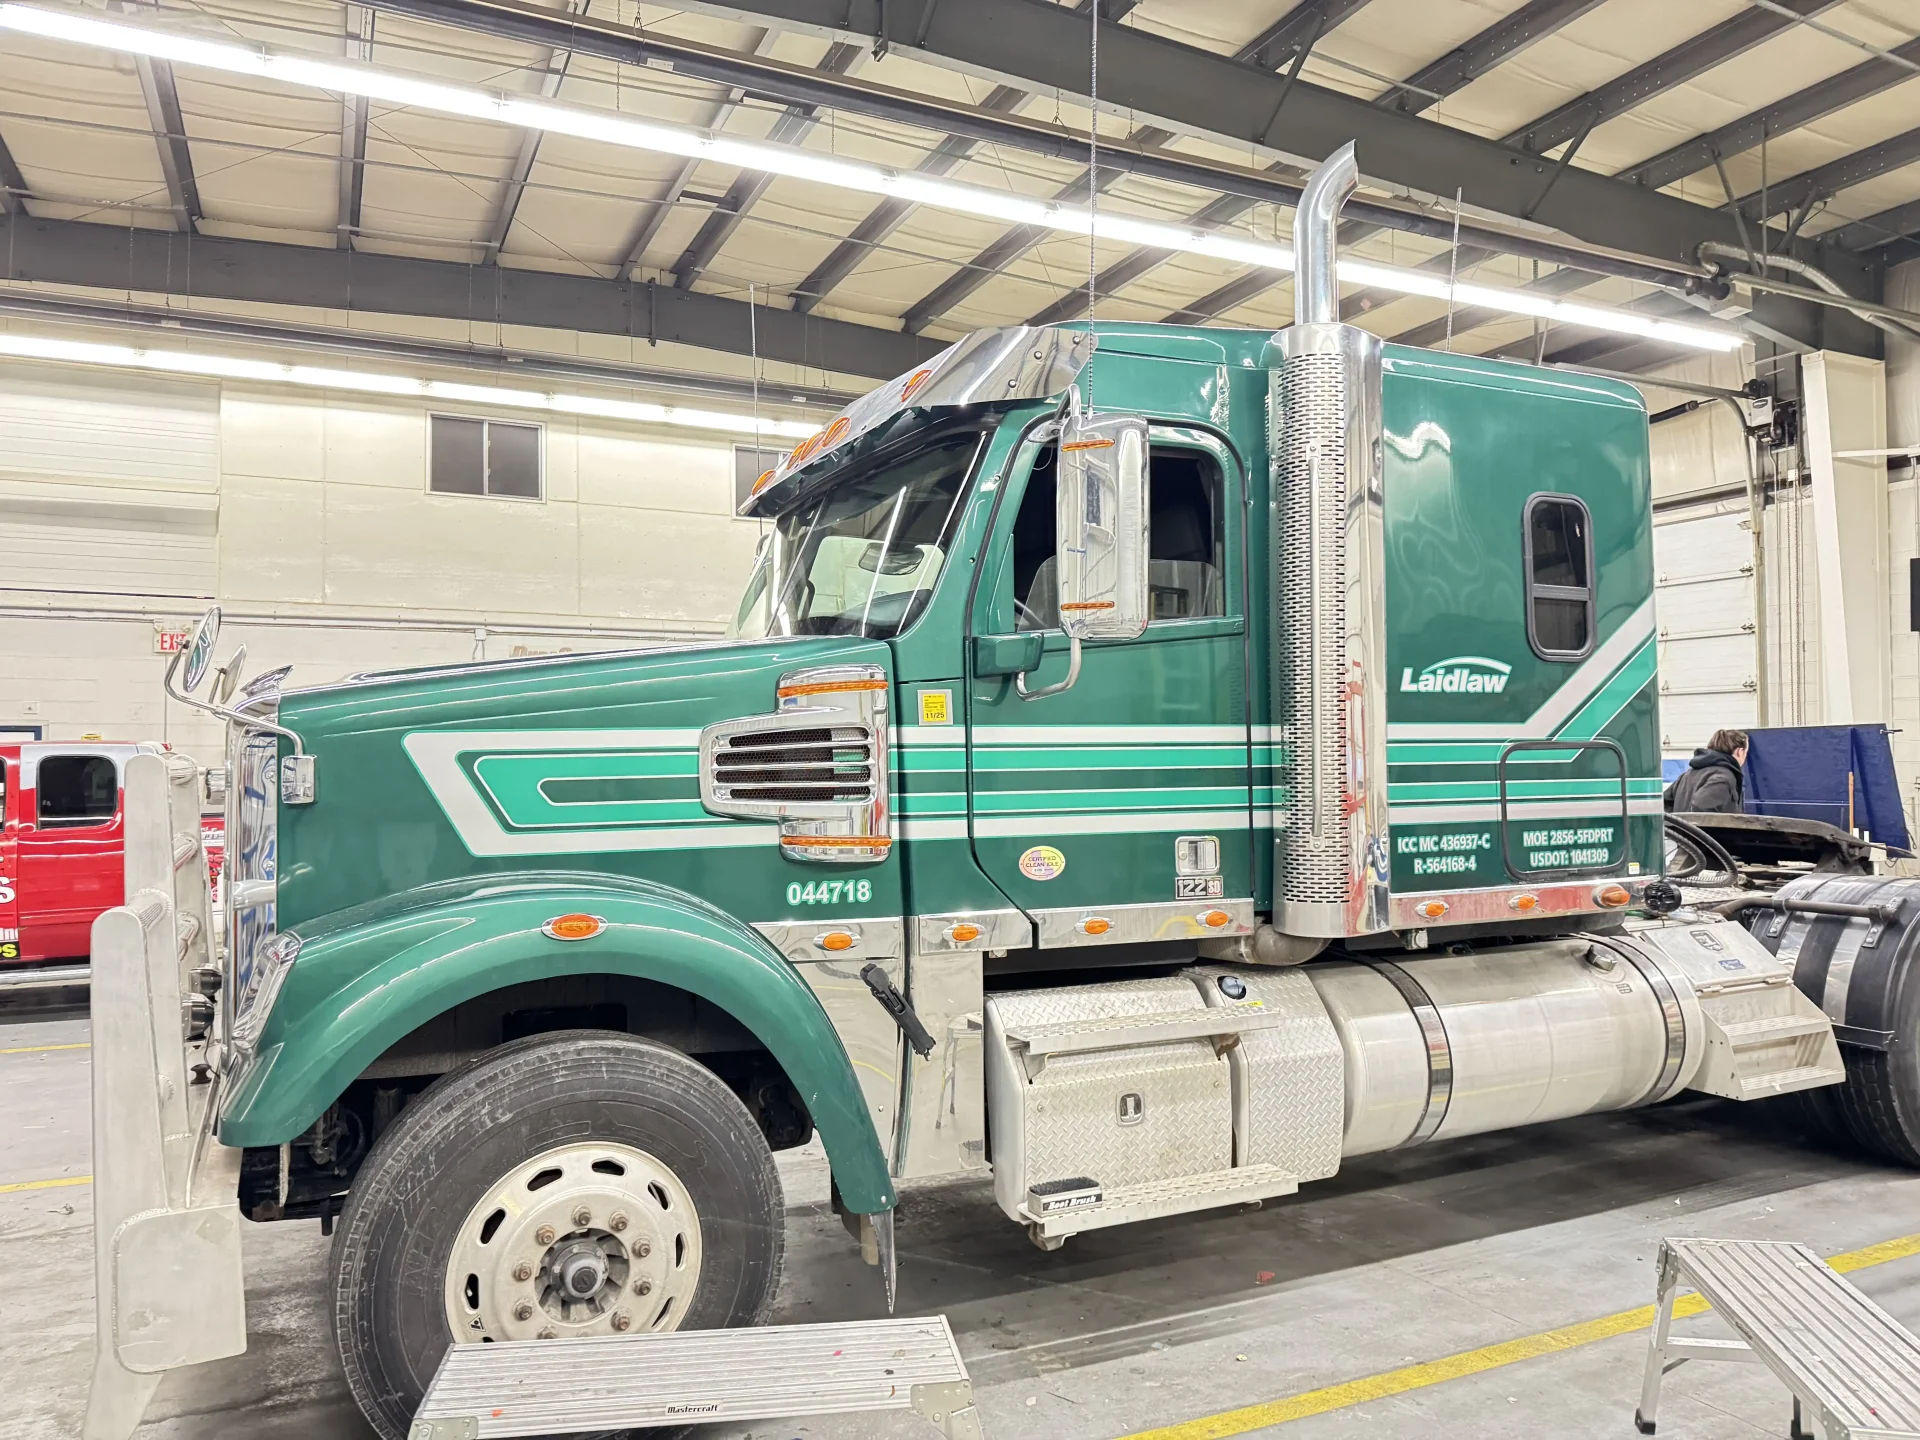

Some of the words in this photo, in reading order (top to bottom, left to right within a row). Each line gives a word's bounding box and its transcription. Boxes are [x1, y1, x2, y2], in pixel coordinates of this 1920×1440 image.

[1400, 667, 1509, 693] Laidlaw
[1397, 837, 1418, 853] ICC
[1419, 835, 1440, 852] MC
[1440, 833, 1491, 851] 436937-C
[1523, 831, 1549, 847] MOE
[1414, 855, 1477, 874] R-564168-4
[1530, 850, 1569, 867] USDOT:
[1570, 848, 1609, 865] 1041309
[787, 879, 872, 905] 044718
[1178, 878, 1206, 897] 122
[1069, 1195, 1097, 1206] Brush
[667, 1404, 718, 1414] Mastercraft
